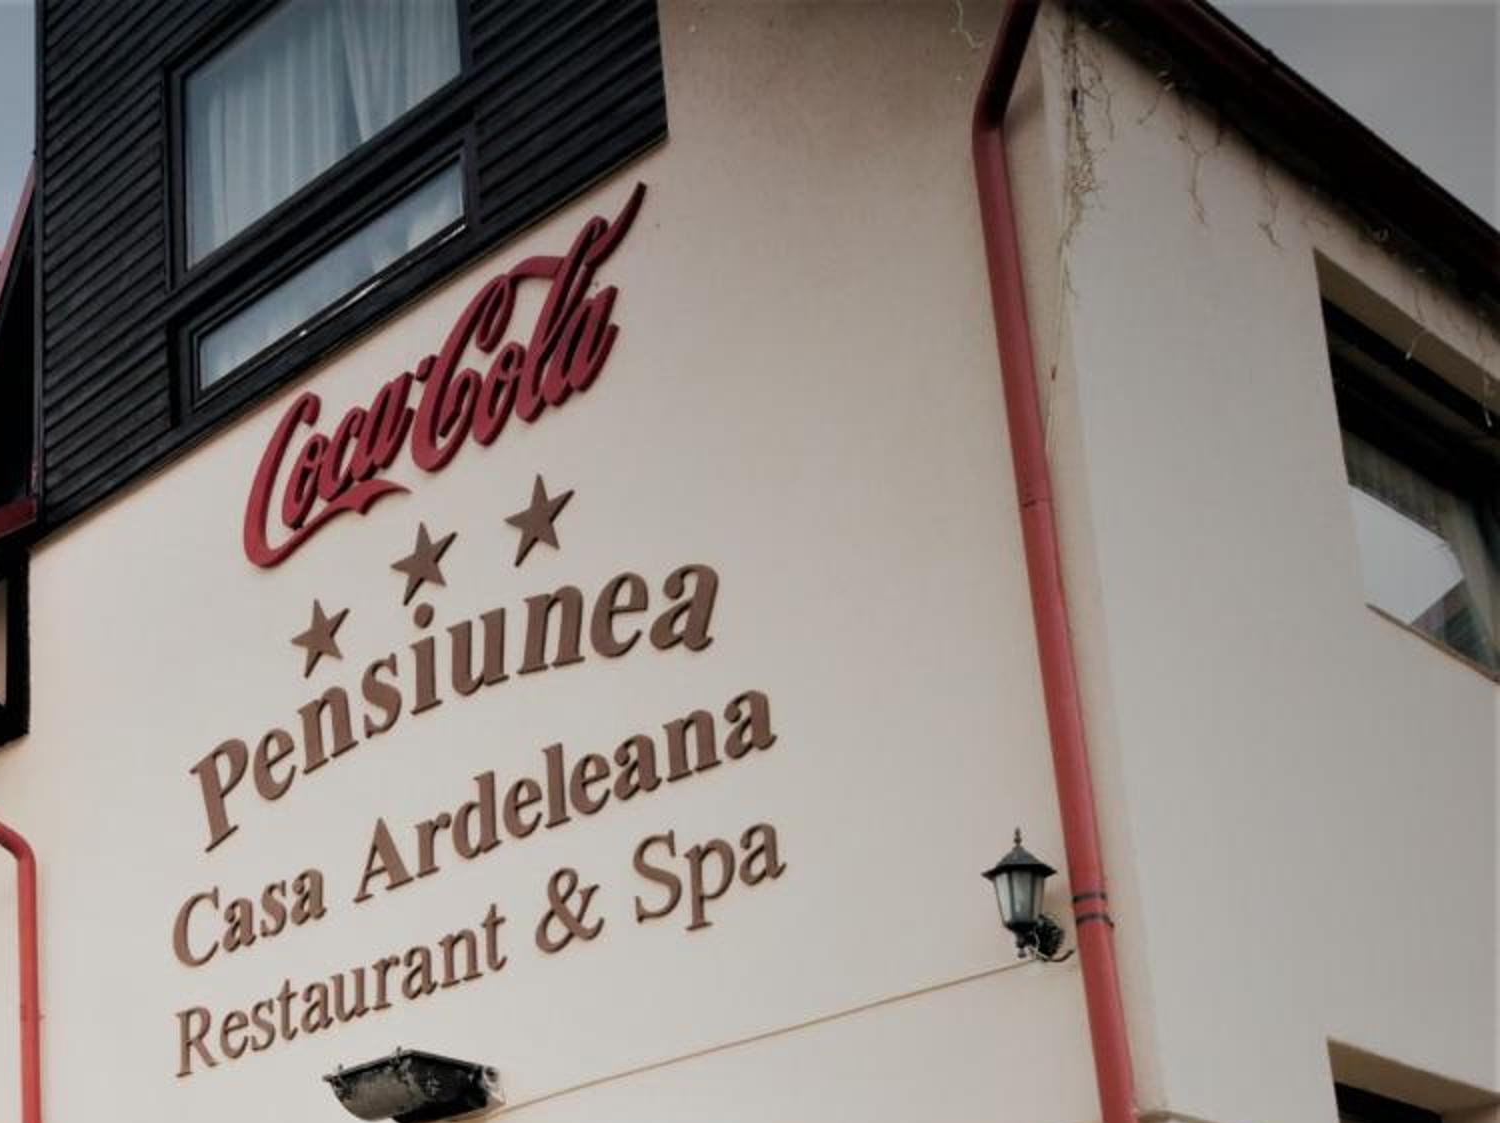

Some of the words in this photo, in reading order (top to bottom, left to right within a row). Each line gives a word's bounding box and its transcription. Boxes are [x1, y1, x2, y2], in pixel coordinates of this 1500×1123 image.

[172, 868, 327, 967] Casa
[353, 690, 777, 903] Ardeleana
[190, 563, 719, 853] Pensiunea
[175, 904, 507, 1078] Restaurant
[534, 867, 605, 955] &
[633, 821, 787, 932] Spa
